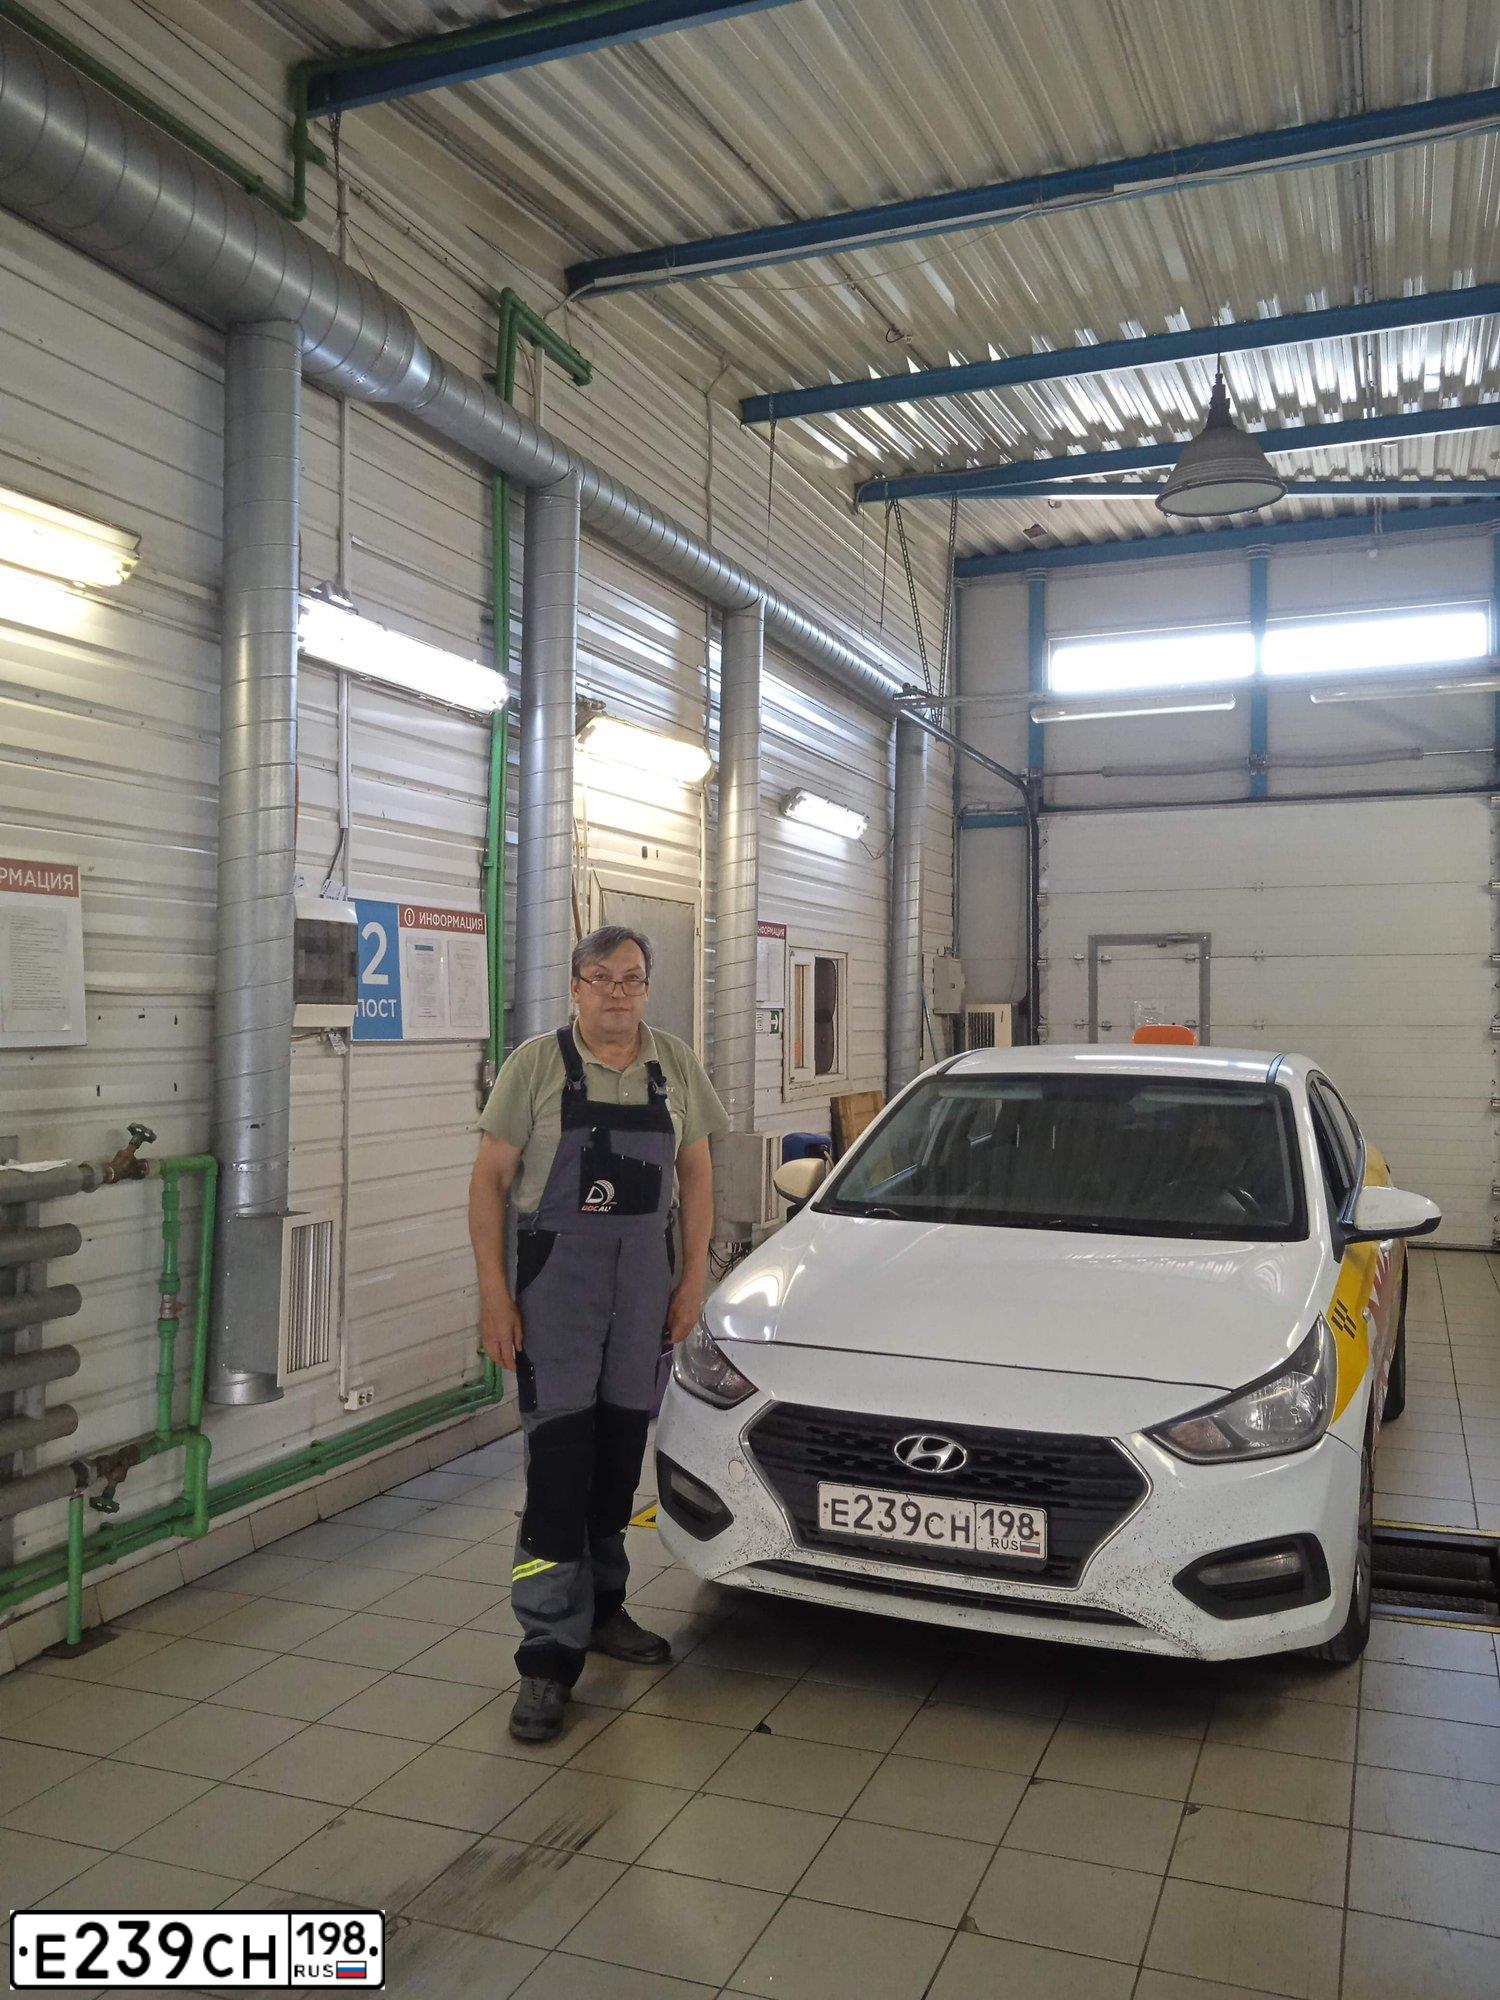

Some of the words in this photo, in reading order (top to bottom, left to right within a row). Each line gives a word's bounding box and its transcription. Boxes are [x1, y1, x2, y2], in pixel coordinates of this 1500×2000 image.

[419, 911, 484, 931] ИНФОРМАЦИЯ
[361, 921, 389, 985] 2
[356, 998, 397, 1018] ПОСТ
[979, 1508, 1035, 1541] 198
[991, 1537, 1019, 1551] RUS
